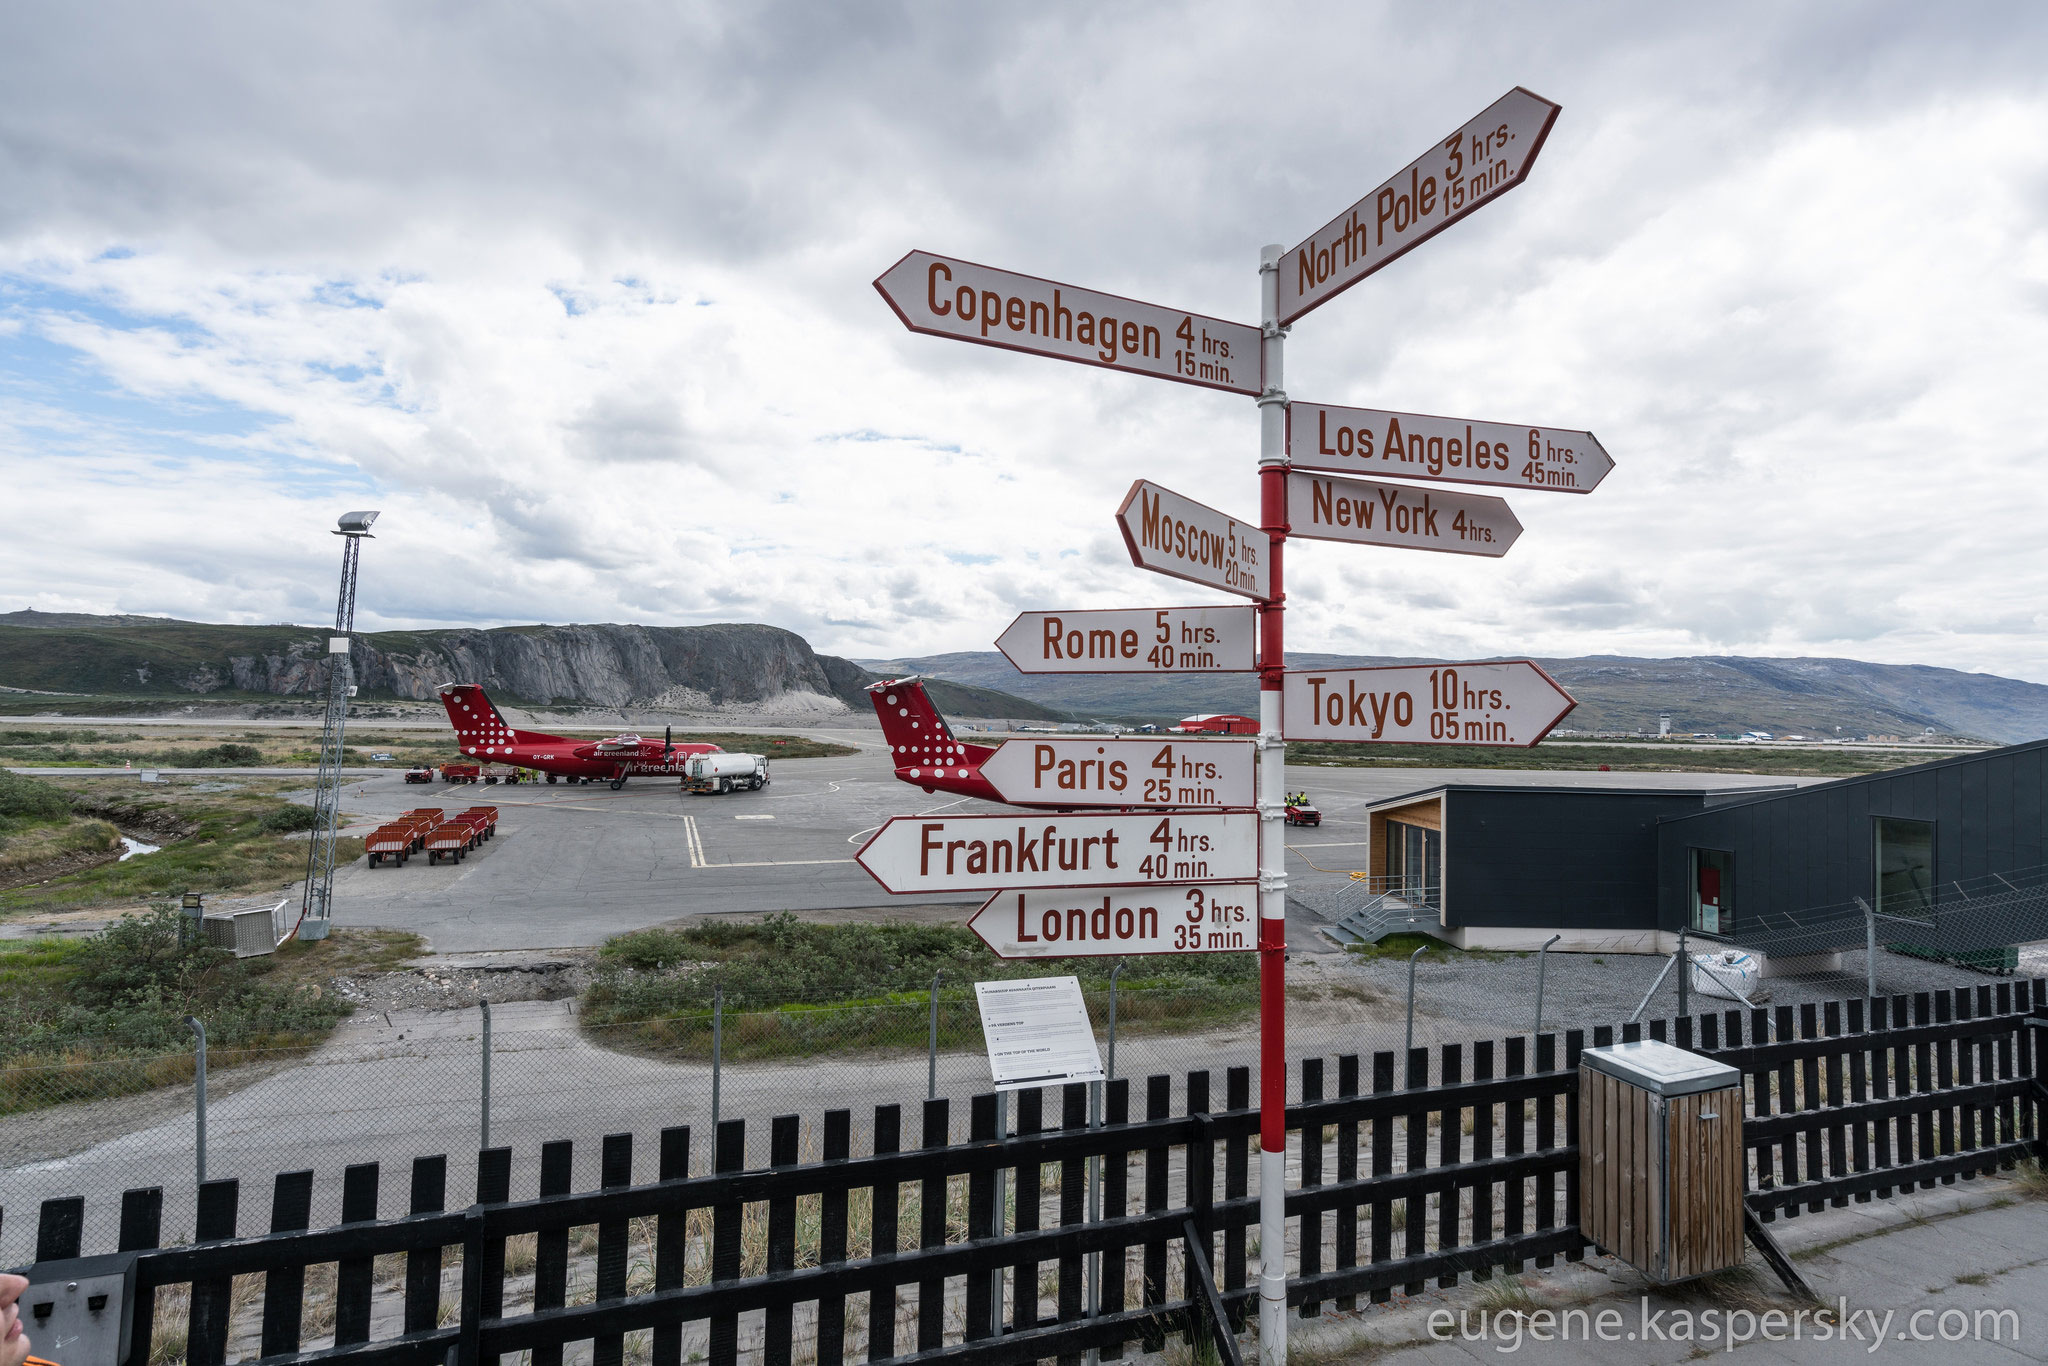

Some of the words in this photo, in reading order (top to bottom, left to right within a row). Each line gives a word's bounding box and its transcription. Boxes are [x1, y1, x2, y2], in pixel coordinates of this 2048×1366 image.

[1298, 210, 1368, 297] North
[1377, 167, 1437, 246] Pole
[1445, 131, 1464, 182] 3
[1470, 122, 1516, 166] hrs.
[1442, 176, 1466, 217] 15
[1469, 157, 1516, 201] min.
[927, 262, 1161, 363] Copenhagen
[1175, 316, 1195, 350] 4
[1202, 328, 1234, 360] hrs.
[1174, 350, 1196, 378] 15
[1199, 360, 1235, 384] min.
[1319, 410, 1374, 458] Los
[1382, 417, 1510, 477] Angeles
[1528, 428, 1541, 461] 6
[1547, 439, 1579, 464] hrs.
[1521, 462, 1546, 485] 45
[1547, 467, 1580, 489] min.
[1142, 487, 1225, 570] Moscow
[1228, 519, 1236, 554] 5
[1241, 543, 1259, 566] hrs.
[1312, 479, 1375, 529] New
[1379, 490, 1439, 538] York
[1451, 509, 1468, 540] 4
[1469, 519, 1496, 543] hrs.
[1225, 558, 1239, 586] 20
[1240, 568, 1258, 592] min.
[1043, 616, 1140, 660] Rome
[1156, 611, 1171, 644] 5
[1181, 621, 1221, 645] hrs.
[1147, 645, 1175, 669] 40
[1179, 646, 1221, 670] min.
[1307, 677, 1414, 740] Tokyo
[1429, 668, 1459, 710] 10
[1463, 680, 1511, 710] hrs.
[1430, 711, 1460, 741] 05
[1464, 715, 1515, 743] min.
[638, 761, 685, 772] greenla
[1034, 743, 1128, 792] Paris
[1152, 744, 1176, 778] 4
[1181, 755, 1223, 779] hrs.
[1143, 778, 1173, 804] 25
[1178, 781, 1222, 805] min.
[920, 823, 1120, 876] Frankfurt
[1149, 818, 1174, 853] 4
[1178, 829, 1214, 852] hrs.
[1139, 854, 1168, 880] 40
[1174, 855, 1214, 879] min.
[1017, 893, 1159, 942] London
[1185, 888, 1204, 923] 3
[1211, 899, 1250, 922] hrs.
[1173, 925, 1202, 950] 35
[1208, 925, 1251, 950] min.
